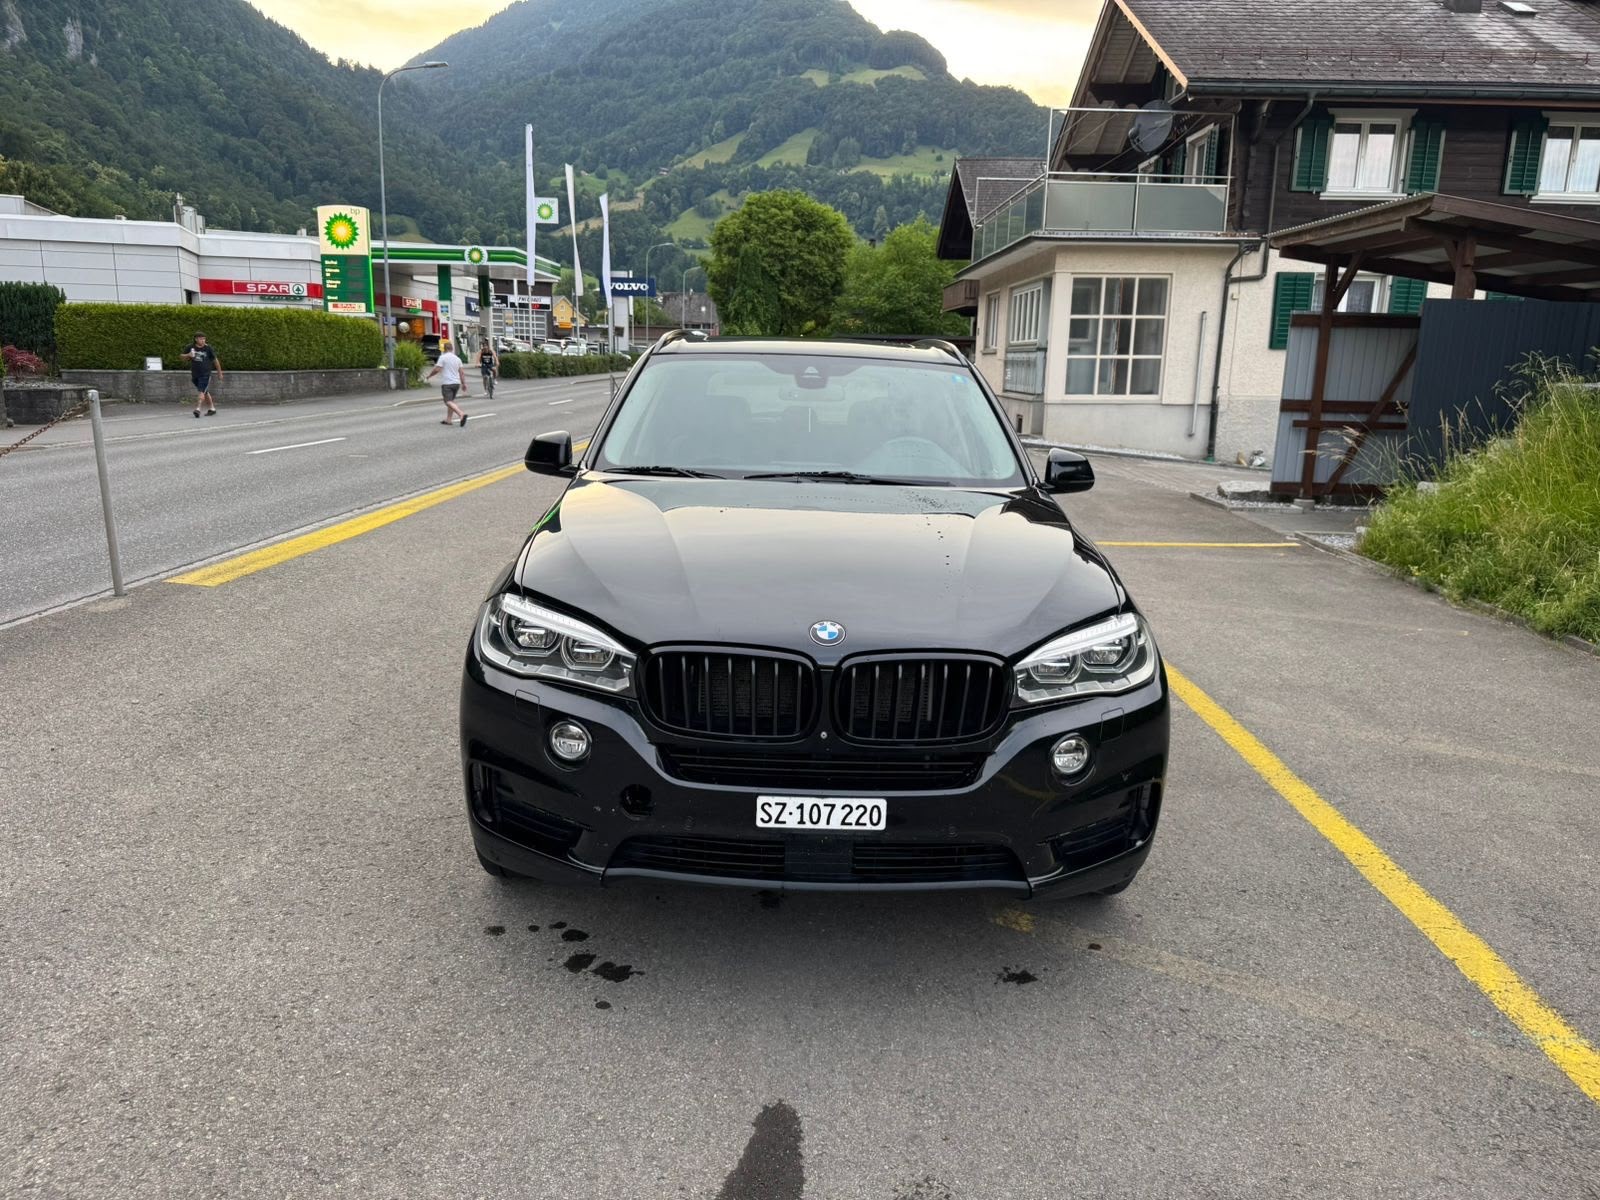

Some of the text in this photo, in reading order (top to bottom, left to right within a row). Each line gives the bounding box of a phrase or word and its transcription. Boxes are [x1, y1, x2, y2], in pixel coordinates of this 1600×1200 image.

[351, 207, 361, 216] bp
[246, 283, 289, 293] SPAR
[609, 282, 649, 291] VOLVO
